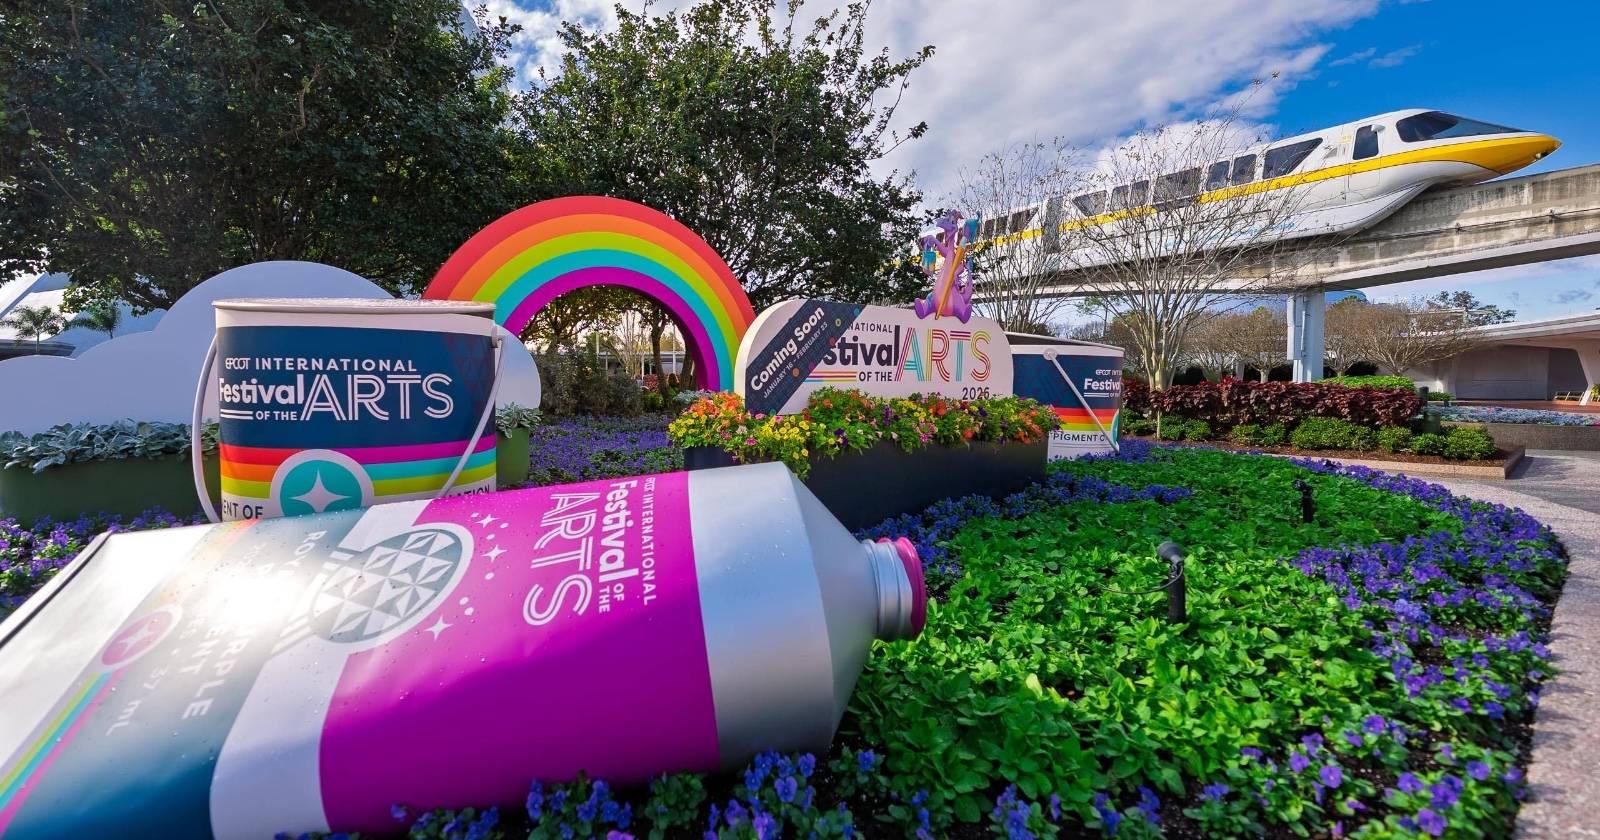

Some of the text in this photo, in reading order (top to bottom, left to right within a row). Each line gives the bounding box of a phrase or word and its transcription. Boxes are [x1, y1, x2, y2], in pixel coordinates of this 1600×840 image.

[850, 322, 892, 333] NATIONAL
[750, 307, 825, 391] Coming Soon
[823, 325, 900, 366] stival
[895, 327, 992, 382] ARTS
[225, 357, 417, 372] EPCOT INTERNATIONAL
[763, 367, 787, 398] JANUARY
[796, 330, 821, 359] FEBRUARY
[859, 371, 892, 382] OF THE
[219, 373, 304, 405] Festival
[300, 373, 454, 421] ARTS
[962, 386, 990, 400] 2026
[1083, 377, 1120, 390] Festiva
[255, 410, 298, 421] OF THE
[1053, 432, 1098, 442] PIGMENT
[223, 500, 264, 520] ENT OF
[599, 480, 640, 583] Festival
[522, 492, 601, 626] ARTS
[641, 492, 657, 606] INTERNATIONAL
[598, 585, 611, 613] THE
[613, 583, 625, 602] OF
